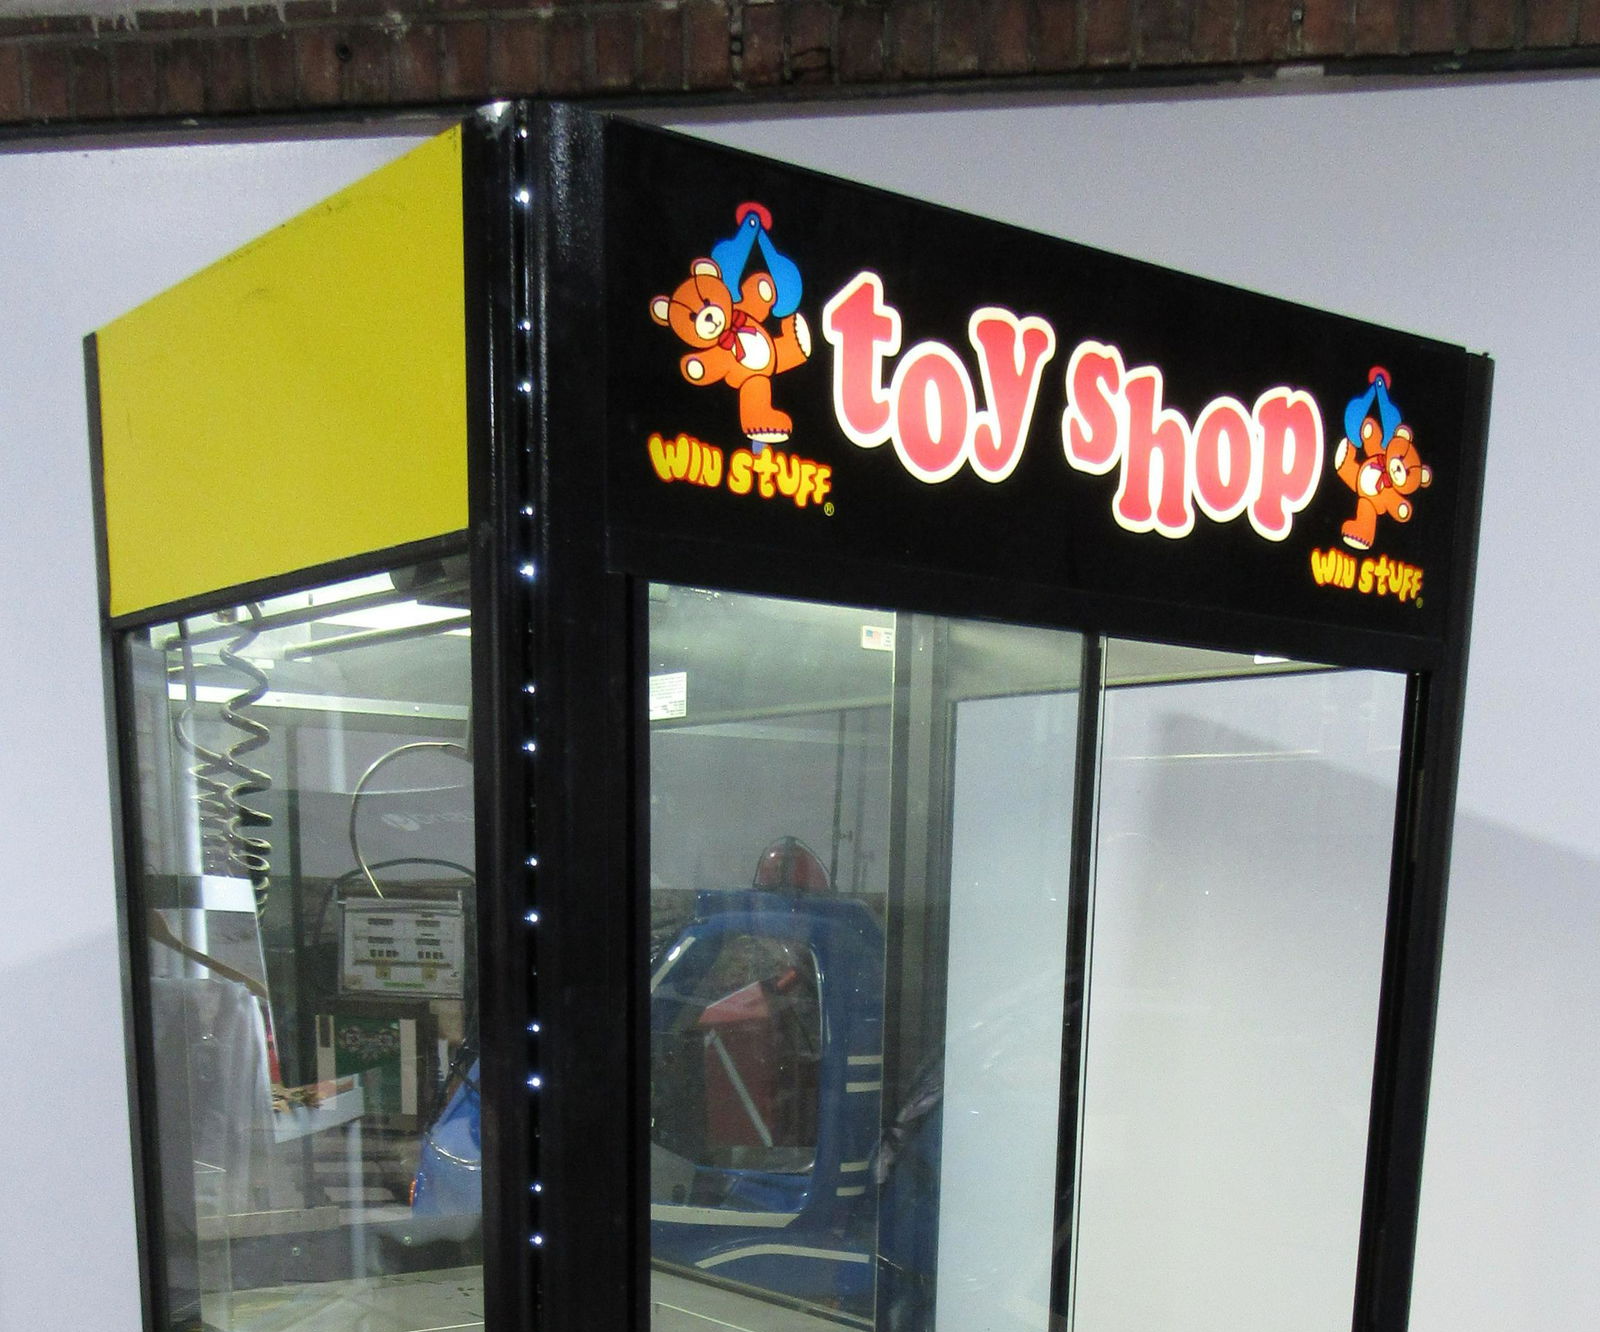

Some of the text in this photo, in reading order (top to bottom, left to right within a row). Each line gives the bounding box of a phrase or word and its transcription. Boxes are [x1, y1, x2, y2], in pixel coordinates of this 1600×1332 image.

[823, 271, 1325, 542] toy shop
[648, 432, 723, 488] WIN
[1311, 548, 1357, 589] WIN
